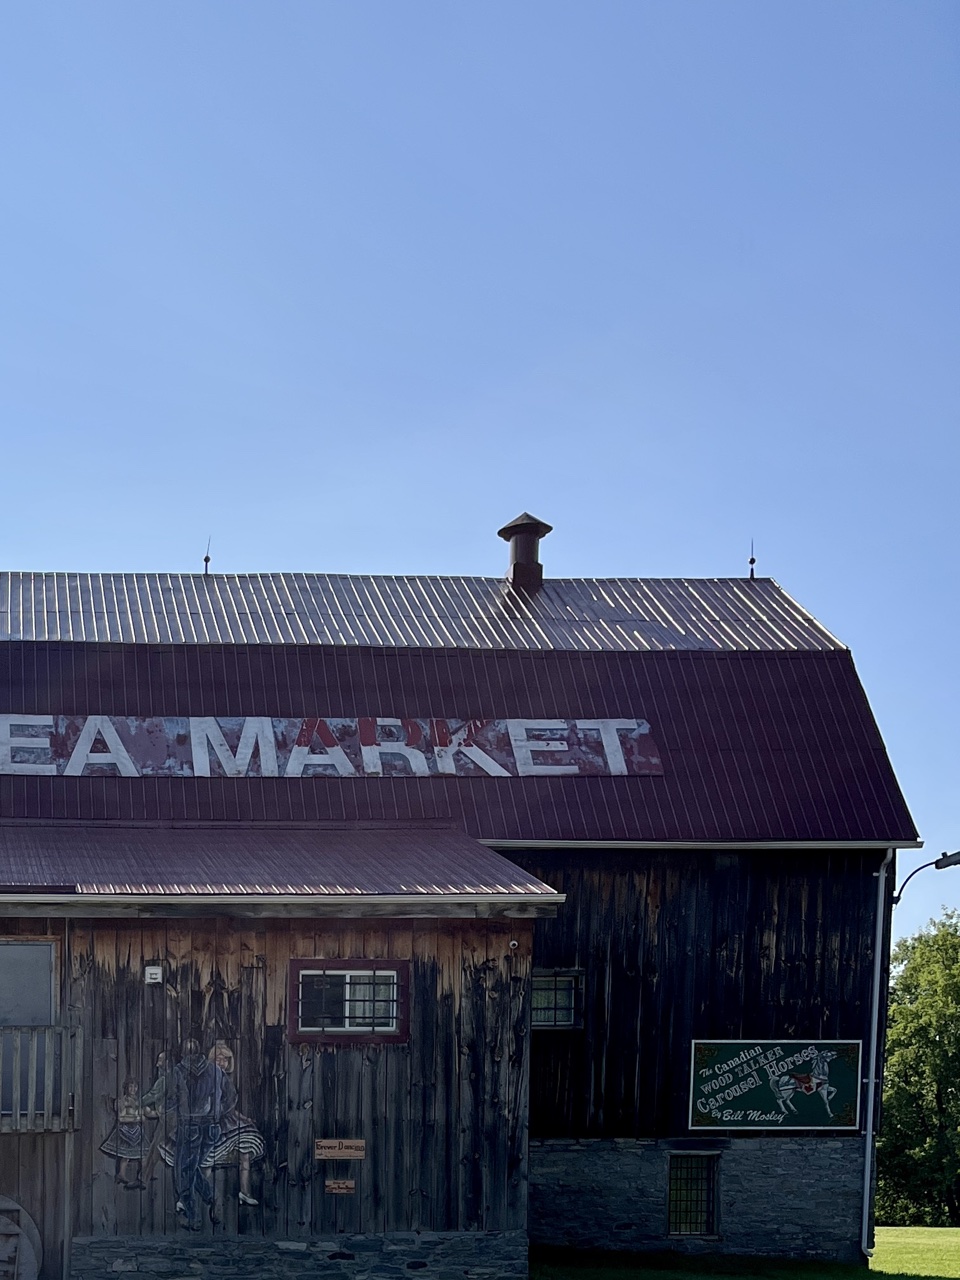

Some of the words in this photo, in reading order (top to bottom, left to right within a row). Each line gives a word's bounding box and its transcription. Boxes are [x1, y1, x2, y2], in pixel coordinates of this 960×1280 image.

[189, 715, 639, 777] MARKET
[696, 1071, 763, 1114] Carousel
[763, 1045, 819, 1079] Horses
[698, 1067, 713, 1077] The
[714, 1045, 764, 1075] Canadian
[700, 1071, 734, 1095] WOOD
[734, 1045, 785, 1078] TALKER
[711, 1108, 722, 1119] By
[722, 1109, 744, 1121] Bill
[745, 1109, 786, 1124] Mosley
